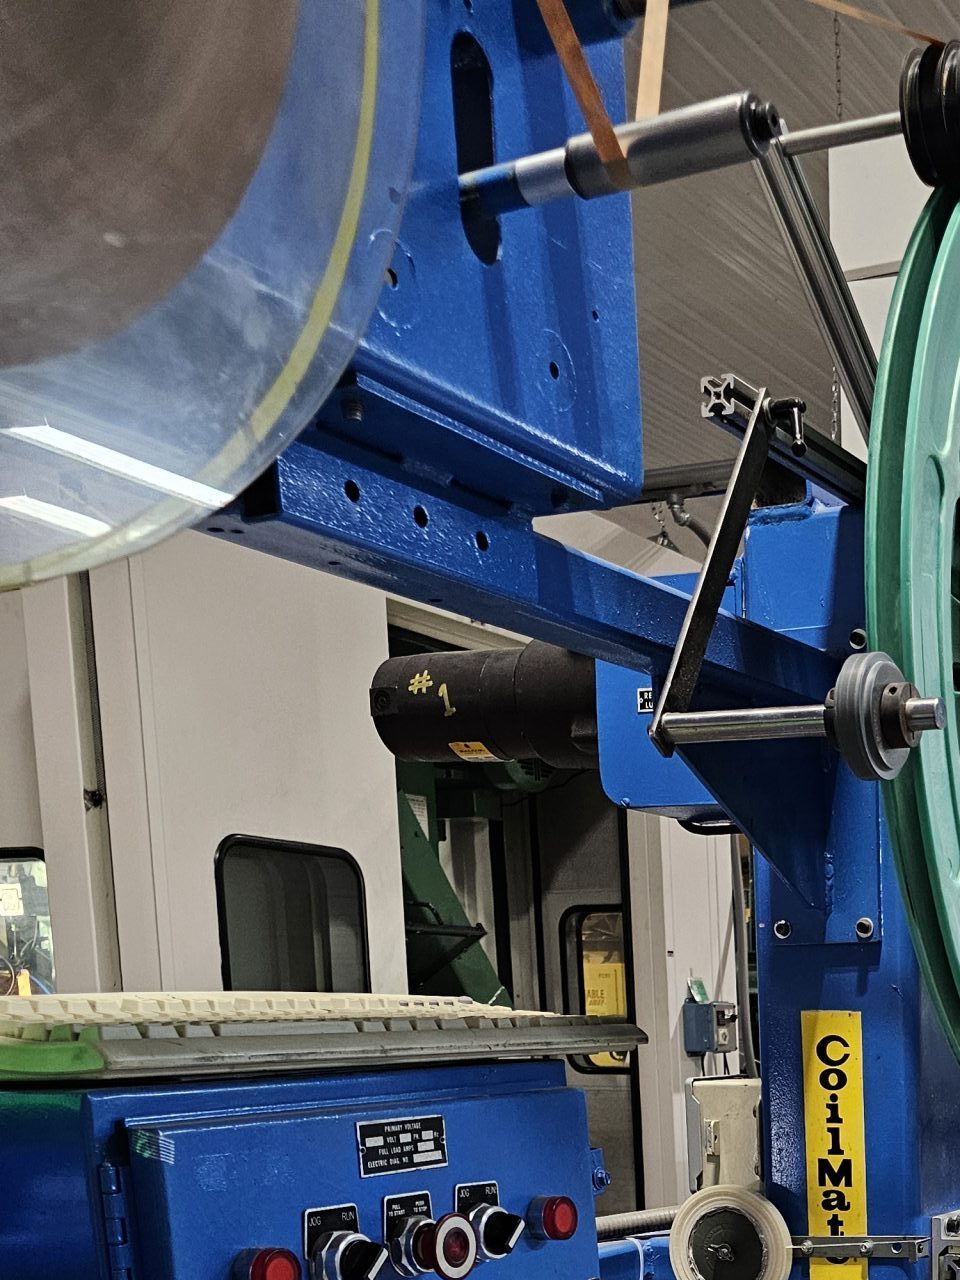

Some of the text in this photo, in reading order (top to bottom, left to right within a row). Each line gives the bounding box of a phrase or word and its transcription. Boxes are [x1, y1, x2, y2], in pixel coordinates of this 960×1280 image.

[643, 691, 653, 700] RE
[645, 701, 654, 709] LU
[384, 1122, 421, 1133] PRIMARY VOLTAGE
[386, 1136, 397, 1144] VOLT
[378, 1144, 415, 1156] FULL LOAD AMPS
[815, 1034, 853, 1265] CoilMat
[367, 1159, 388, 1169] ELECTRIC
[459, 1188, 470, 1198] JOG
[308, 1211, 355, 1228] JOG RUN
